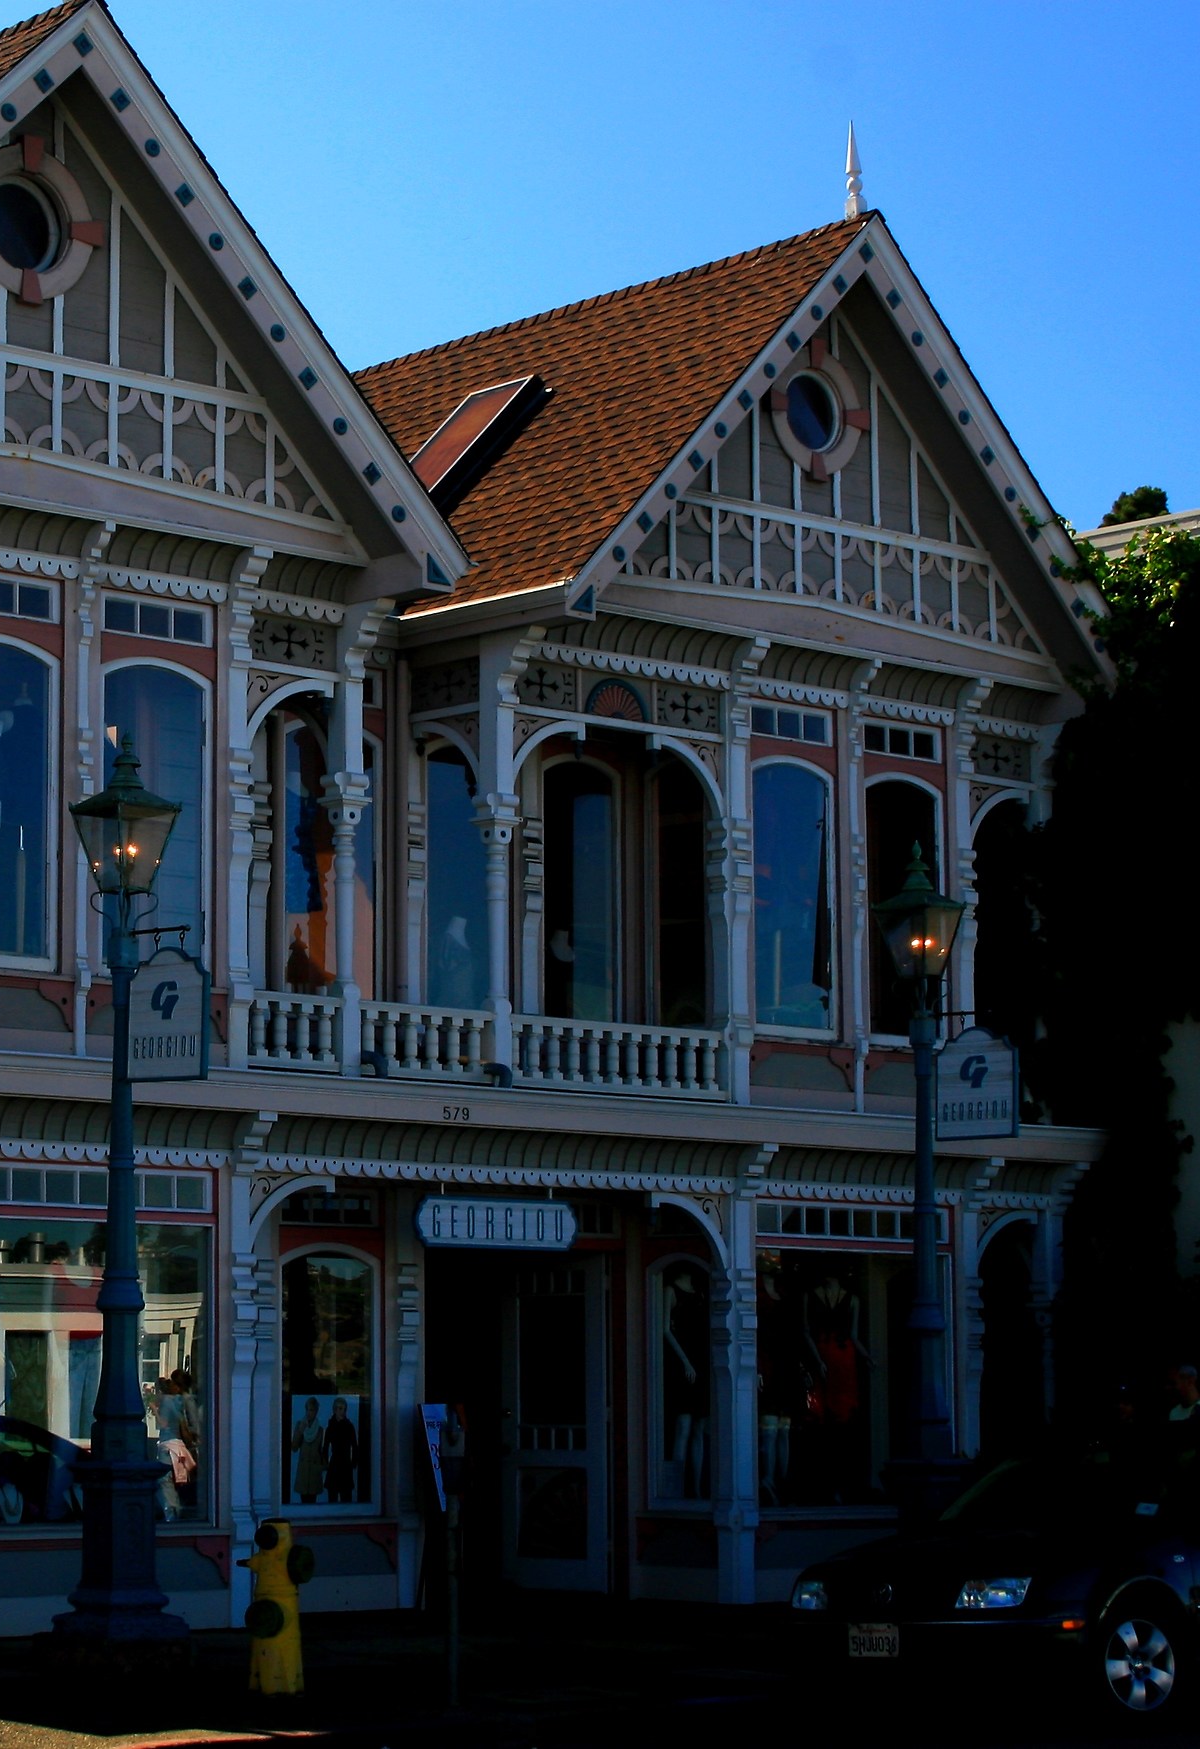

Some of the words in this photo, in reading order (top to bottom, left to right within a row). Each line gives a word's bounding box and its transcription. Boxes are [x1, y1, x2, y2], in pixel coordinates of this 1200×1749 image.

[133, 1034, 197, 1059] GEORGIOU
[443, 1106, 470, 1120] 579
[943, 1100, 1007, 1122] GEORGIOU
[432, 1204, 564, 1242] GEORGIOU
